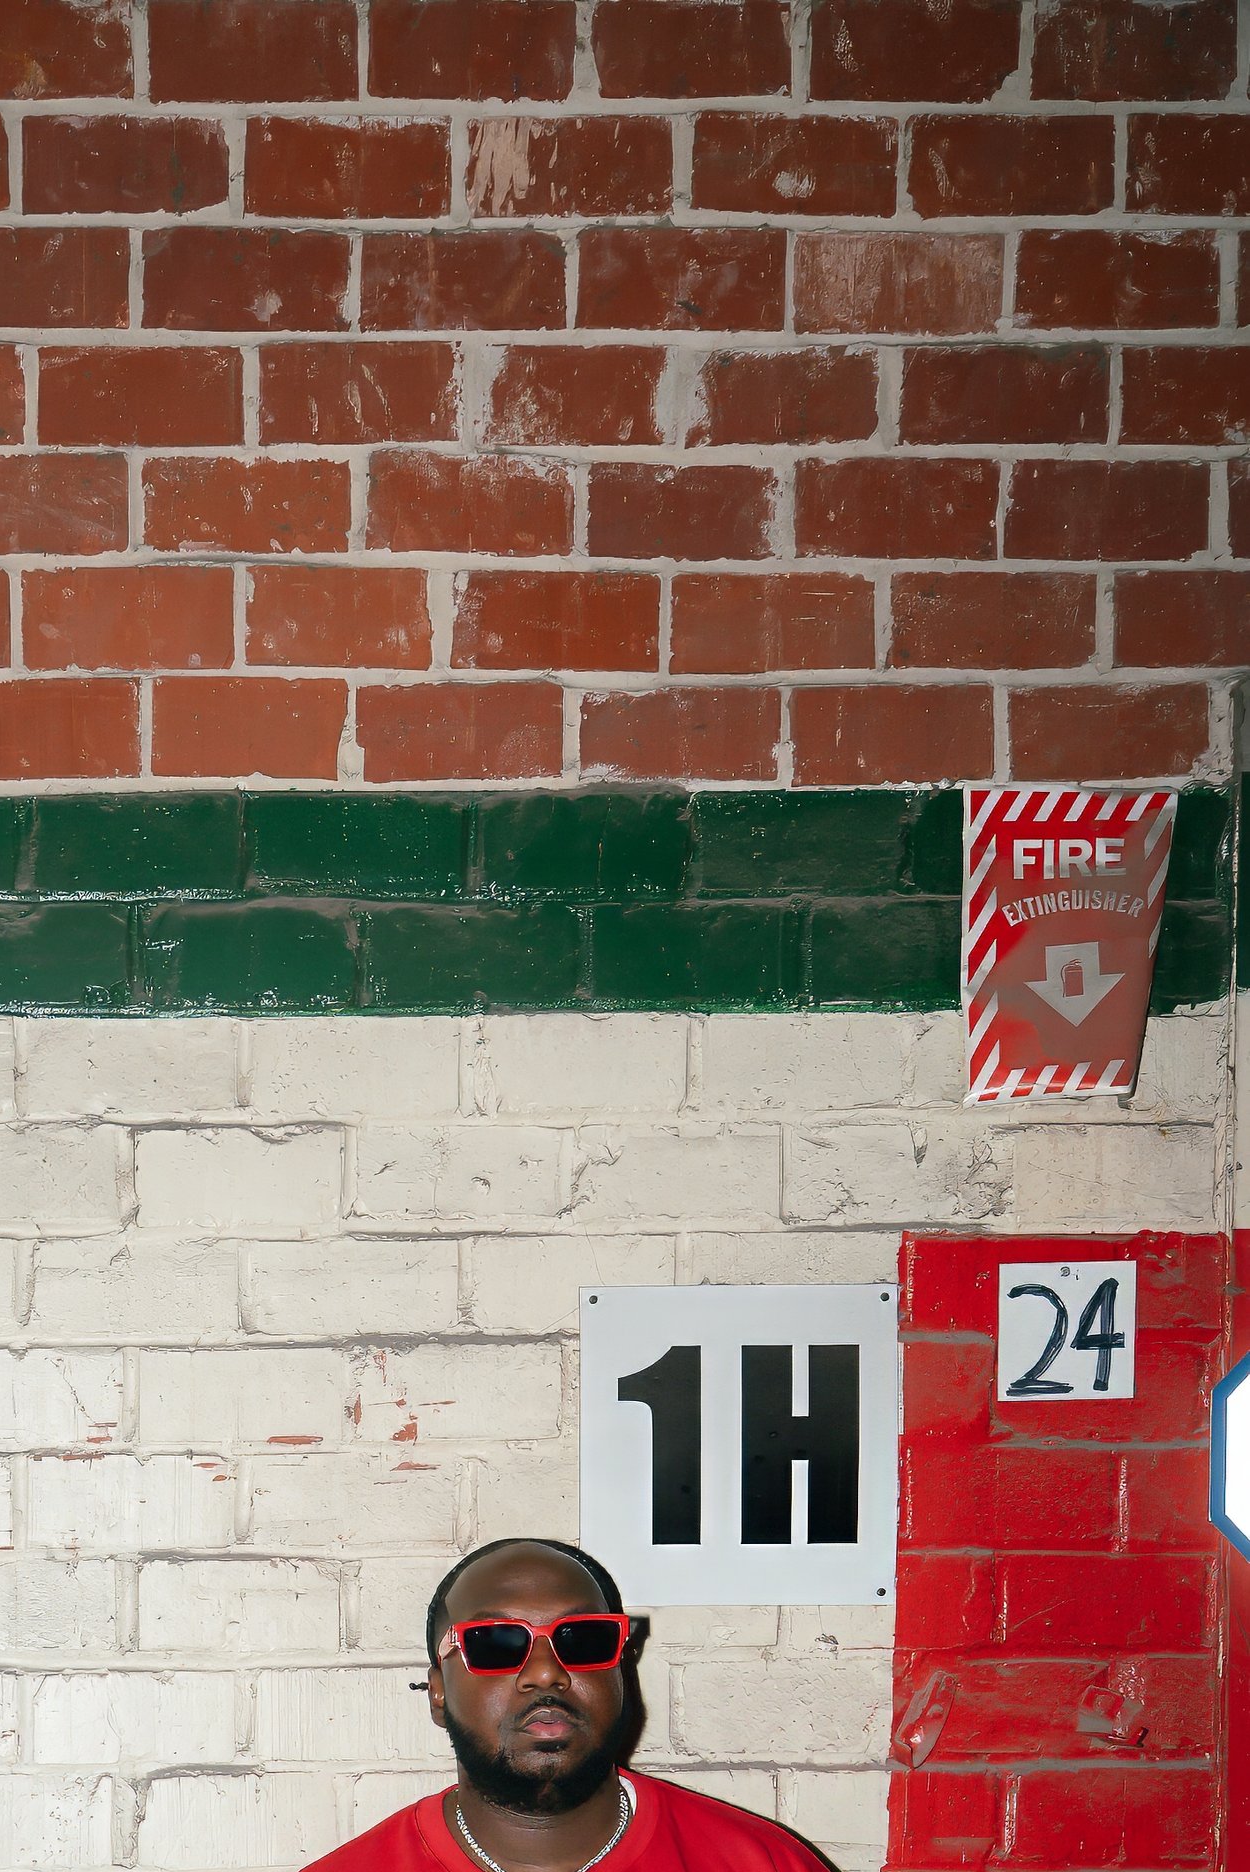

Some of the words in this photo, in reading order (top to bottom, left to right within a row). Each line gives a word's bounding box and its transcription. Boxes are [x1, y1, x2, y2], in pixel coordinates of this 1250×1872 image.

[1013, 838, 1127, 880] FIRE
[1001, 889, 1145, 927] EXTINGUISHER
[1006, 1278, 1125, 1396] 24
[618, 1344, 860, 1545] 1H
